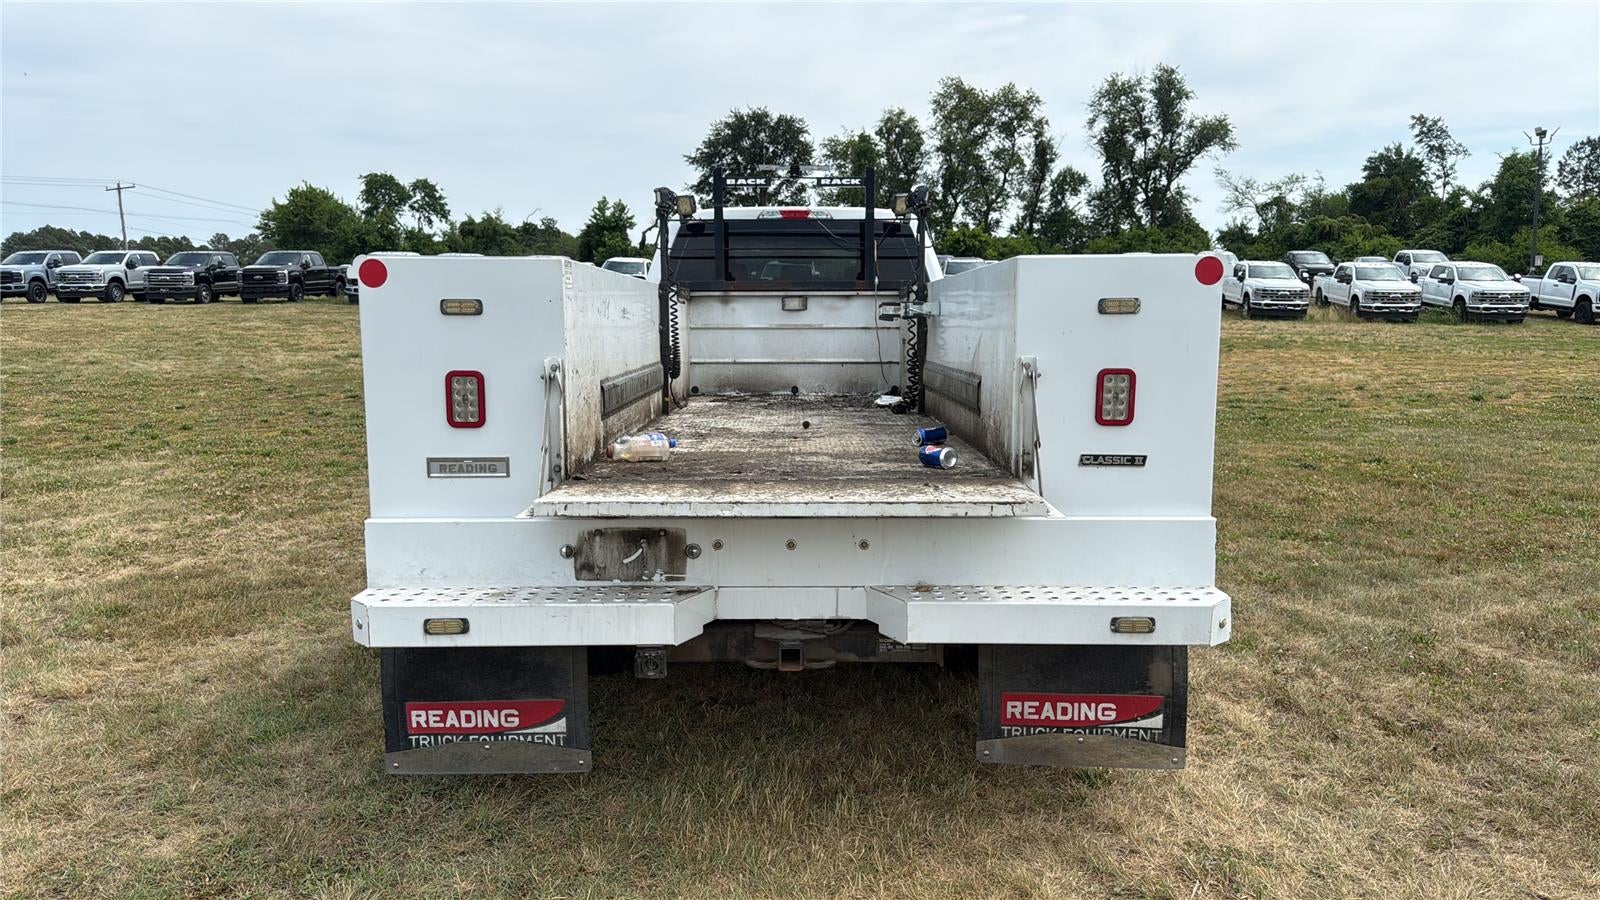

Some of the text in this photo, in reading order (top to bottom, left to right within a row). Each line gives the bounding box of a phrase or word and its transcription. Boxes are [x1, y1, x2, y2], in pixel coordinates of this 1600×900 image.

[1081, 455, 1144, 465] CLASSIC II
[439, 463, 498, 473] READING
[1006, 701, 1117, 721] READING
[410, 709, 520, 728] READING
